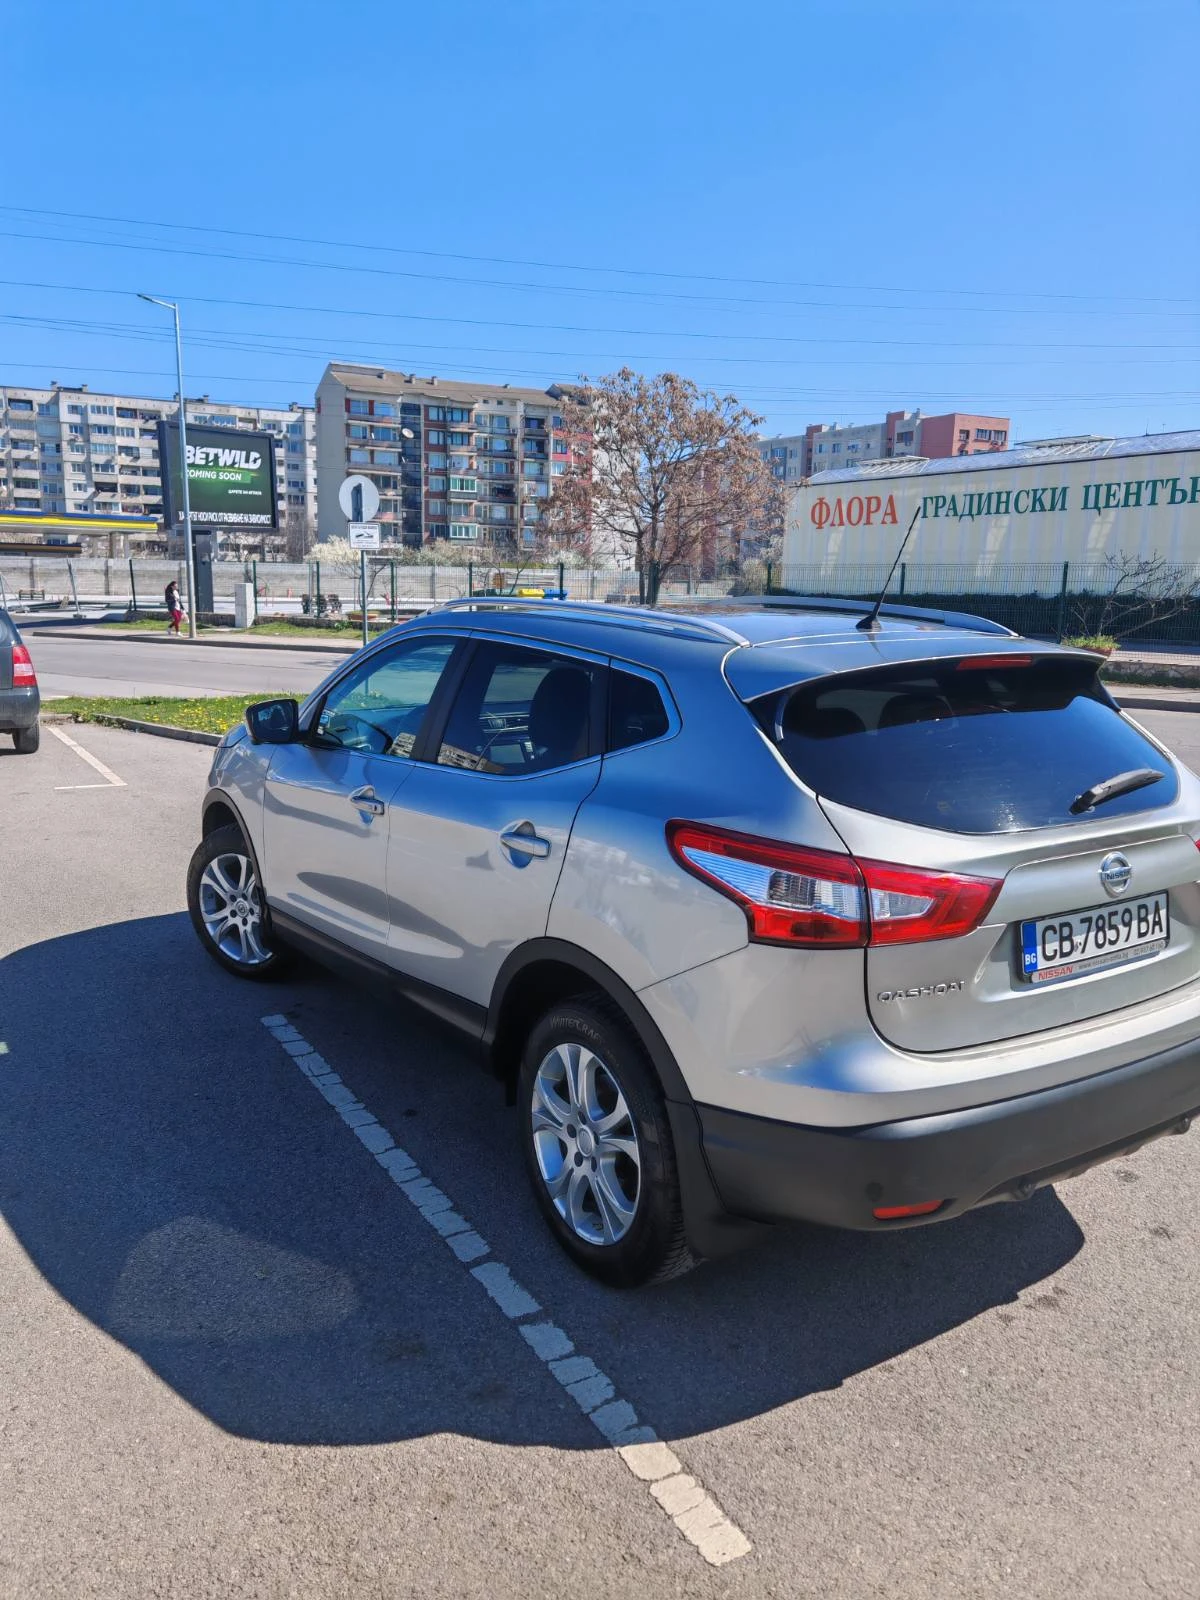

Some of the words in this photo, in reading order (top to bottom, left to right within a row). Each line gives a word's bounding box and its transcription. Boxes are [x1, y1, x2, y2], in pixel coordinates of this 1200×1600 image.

[185, 445, 262, 469] BETWILD
[219, 470, 242, 481] SOON
[810, 494, 899, 529] ФЛОРА
[921, 487, 1070, 521] ГРАДИНСКИ
[1041, 921, 1075, 962] CB
[1079, 908, 1133, 954] 7859
[1137, 900, 1164, 939] BA
[1024, 952, 1037, 965] BG
[1038, 966, 1073, 981] NISSAN
